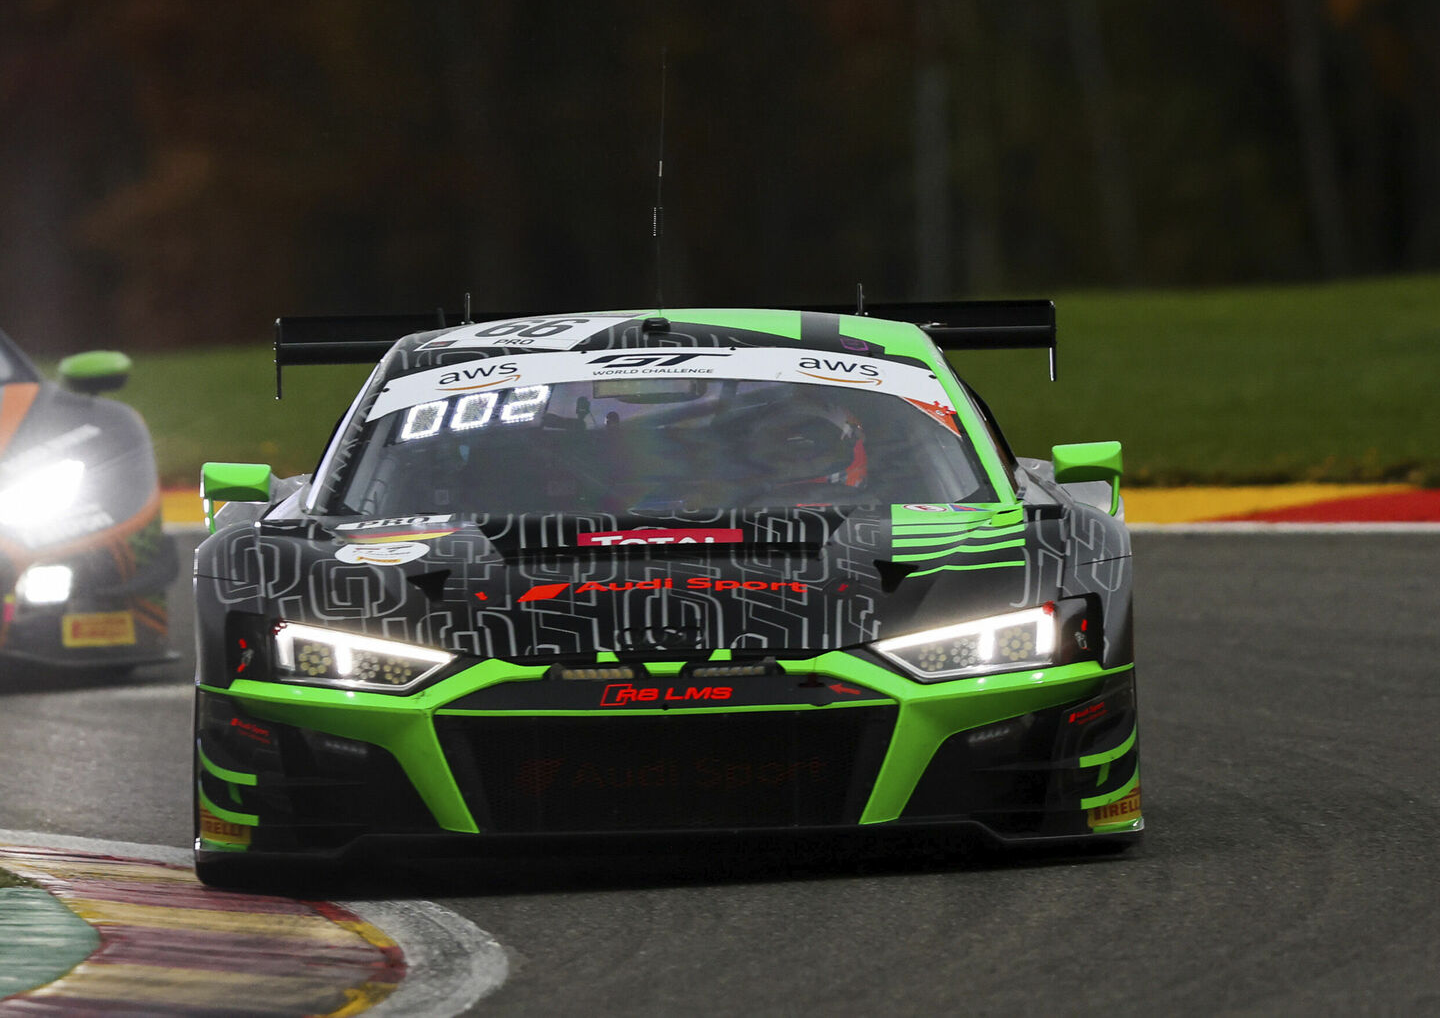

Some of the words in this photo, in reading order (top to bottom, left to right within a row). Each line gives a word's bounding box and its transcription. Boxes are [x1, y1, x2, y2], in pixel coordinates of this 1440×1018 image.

[475, 319, 589, 338] 66
[585, 353, 733, 368] GT
[799, 357, 879, 377] aws
[439, 362, 518, 385] aws
[401, 384, 551, 440] 002
[574, 578, 673, 593] Audi
[686, 577, 809, 593] Sport
[615, 687, 659, 701] R8
[664, 687, 733, 701] LMS
